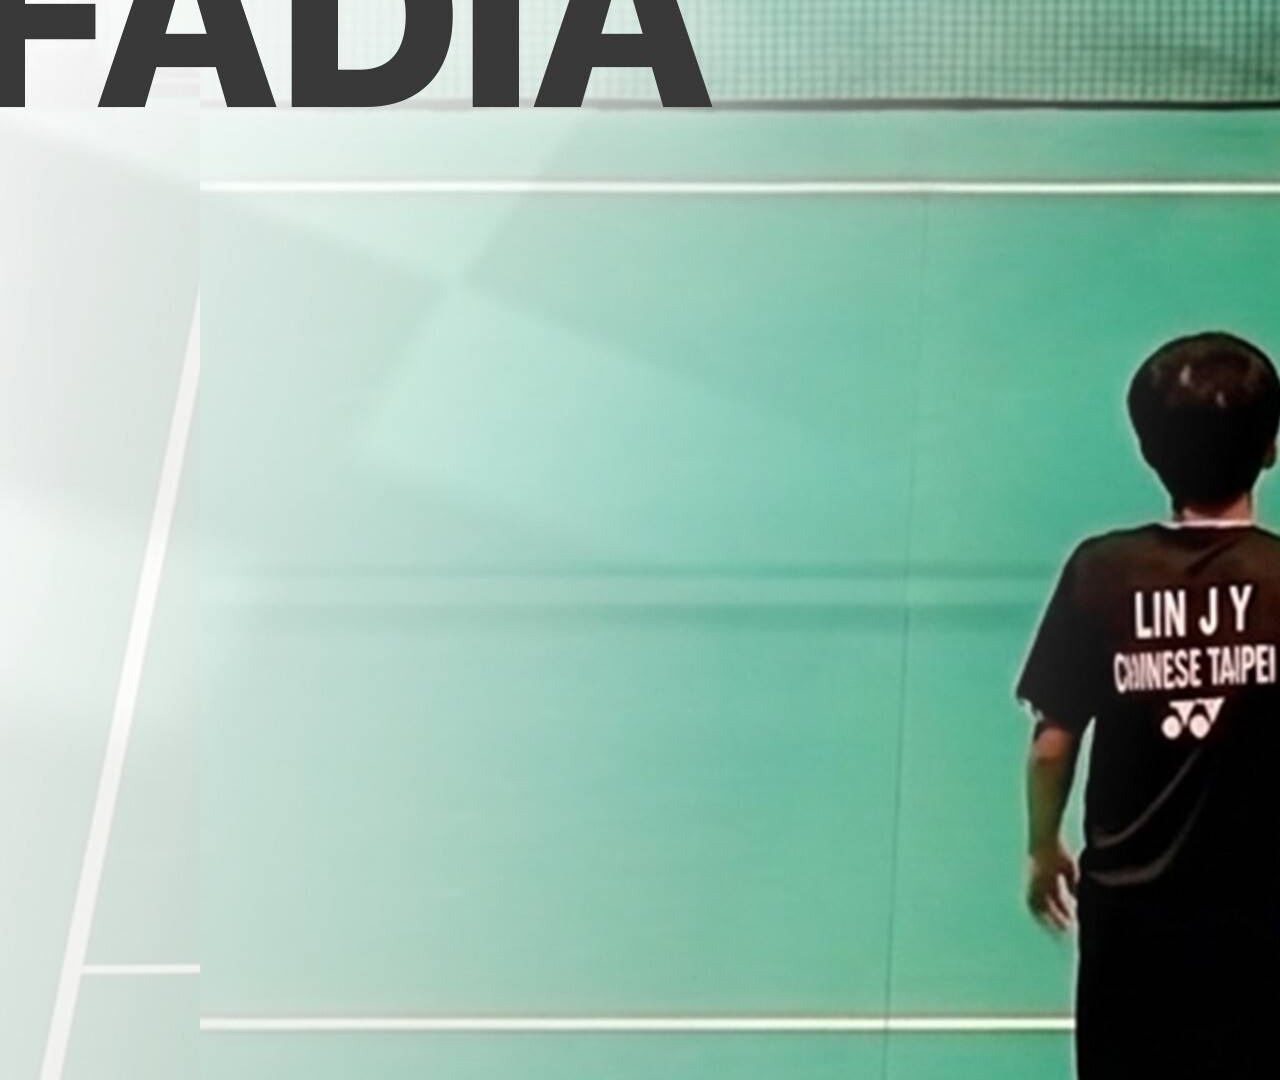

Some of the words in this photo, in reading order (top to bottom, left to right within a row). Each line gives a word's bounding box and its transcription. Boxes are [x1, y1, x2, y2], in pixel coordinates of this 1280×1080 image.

[1134, 588, 1186, 639] LIN
[1198, 585, 1218, 637] J
[1228, 583, 1253, 633] Y
[1113, 647, 1202, 694] CHINESE
[1206, 644, 1277, 686] TAIPEI
